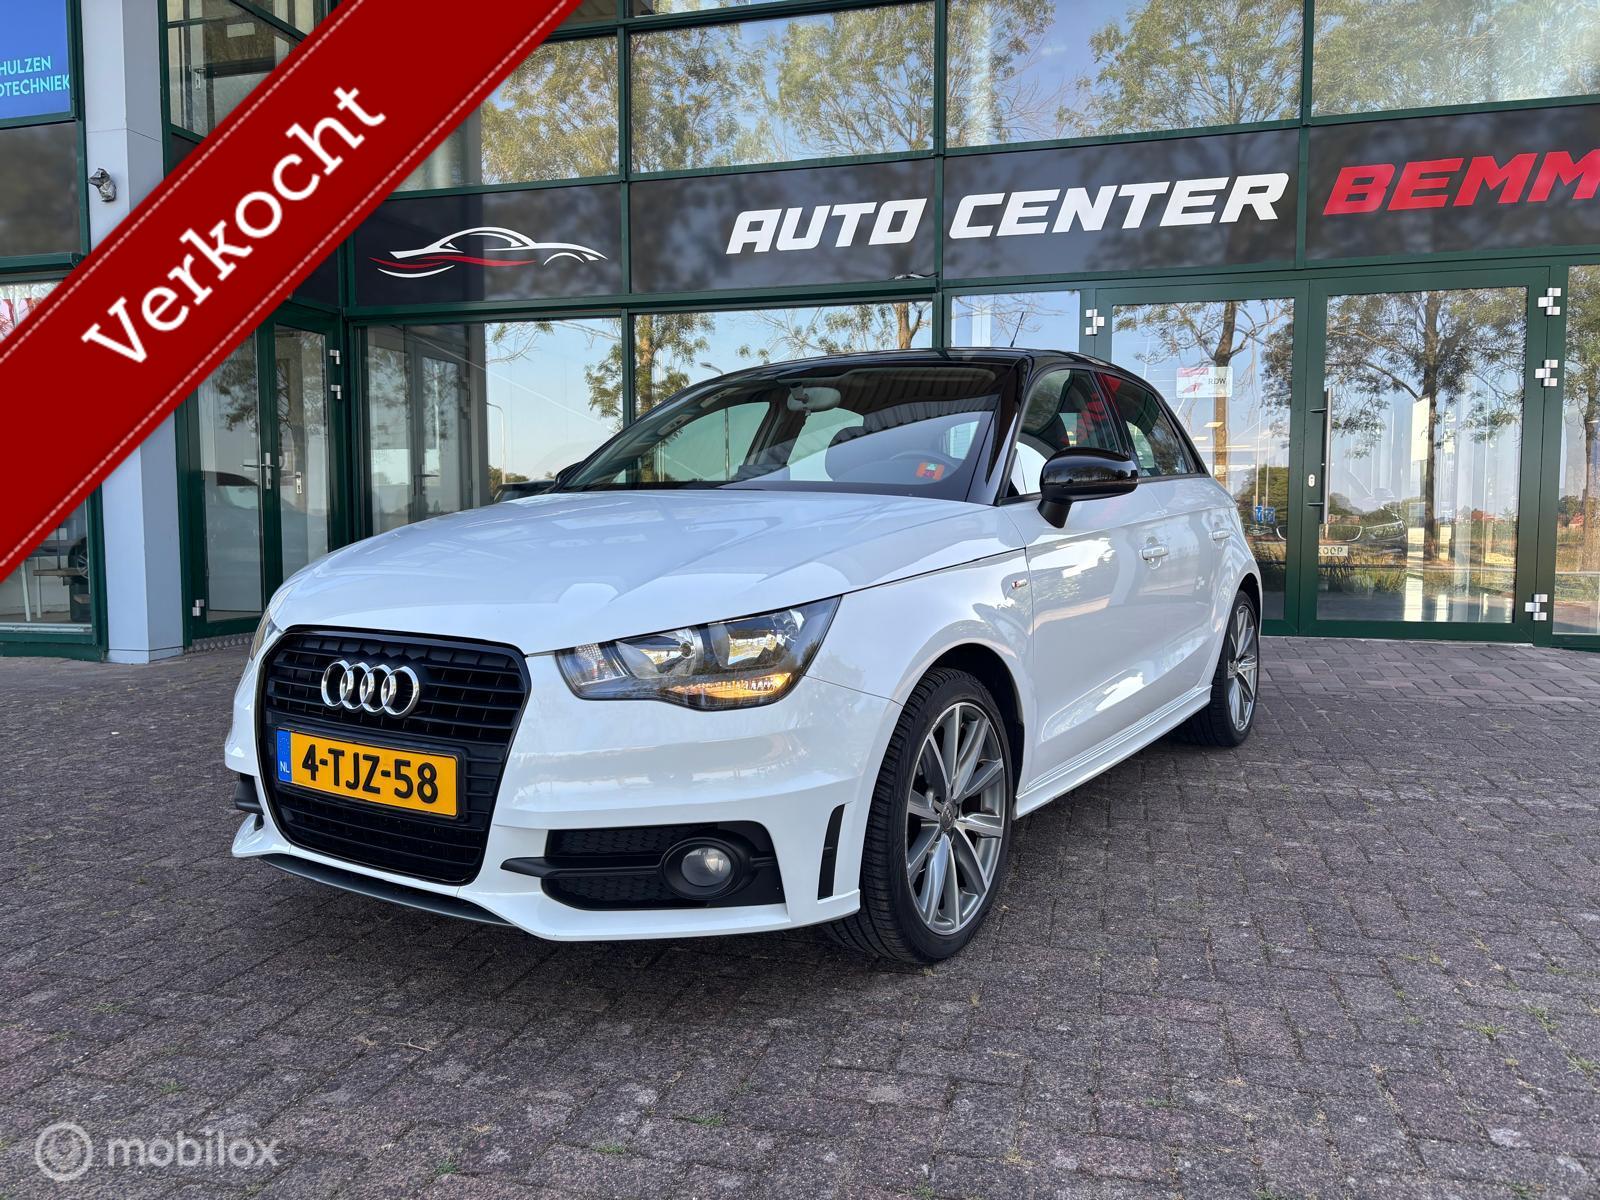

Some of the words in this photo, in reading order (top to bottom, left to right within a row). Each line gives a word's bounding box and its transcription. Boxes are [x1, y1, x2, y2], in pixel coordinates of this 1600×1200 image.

[726, 198, 927, 254] AUTO
[949, 172, 1289, 239] CENTER
[1322, 149, 1600, 216] BEMM
[1208, 377, 1227, 385] RDW
[280, 761, 290, 774] NL
[302, 744, 438, 804] 4-TJZ-58
